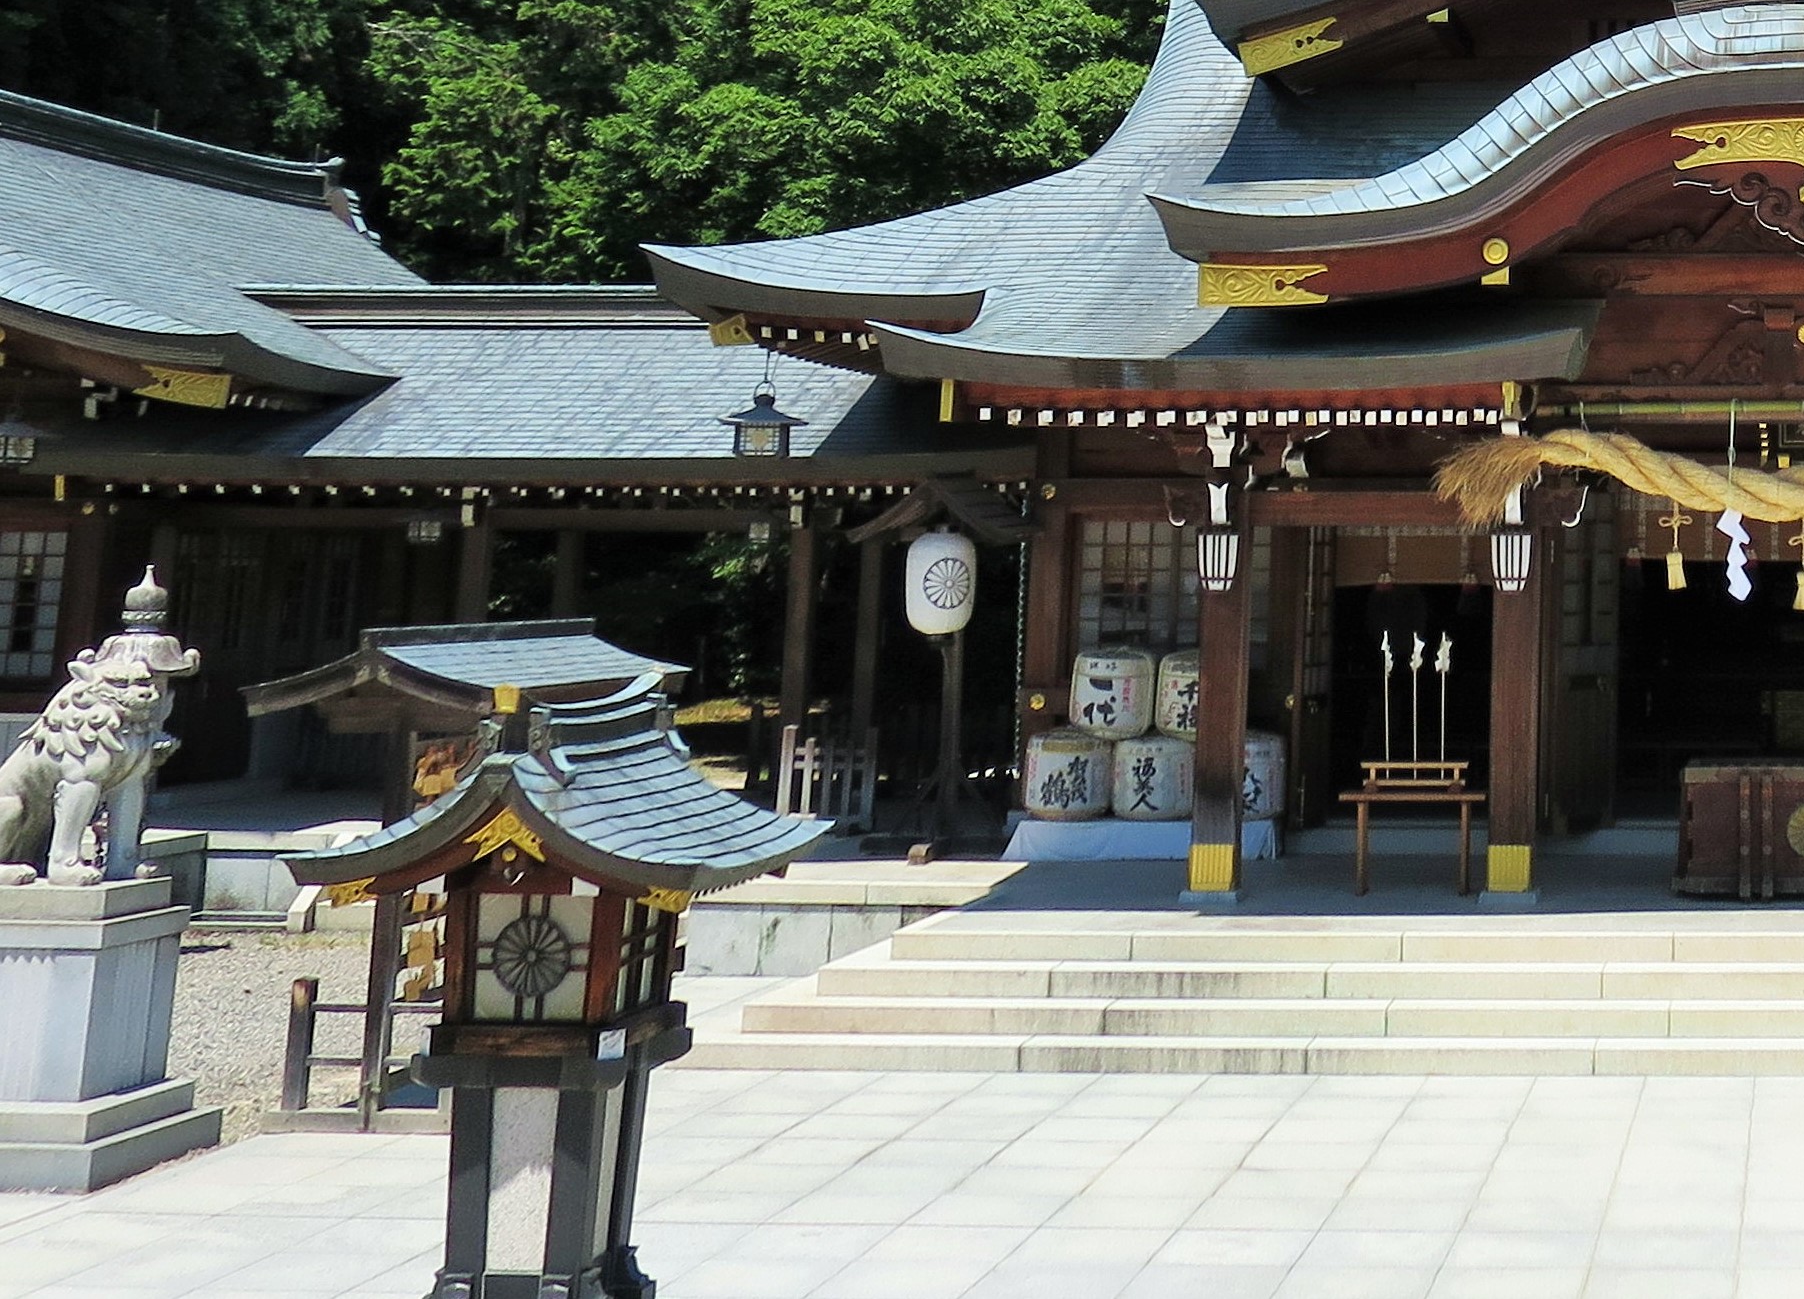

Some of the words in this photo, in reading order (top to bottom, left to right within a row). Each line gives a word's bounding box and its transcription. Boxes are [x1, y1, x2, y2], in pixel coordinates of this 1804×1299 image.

[1083, 678, 1117, 727] 一代
[1130, 757, 1159, 812] 福美人
